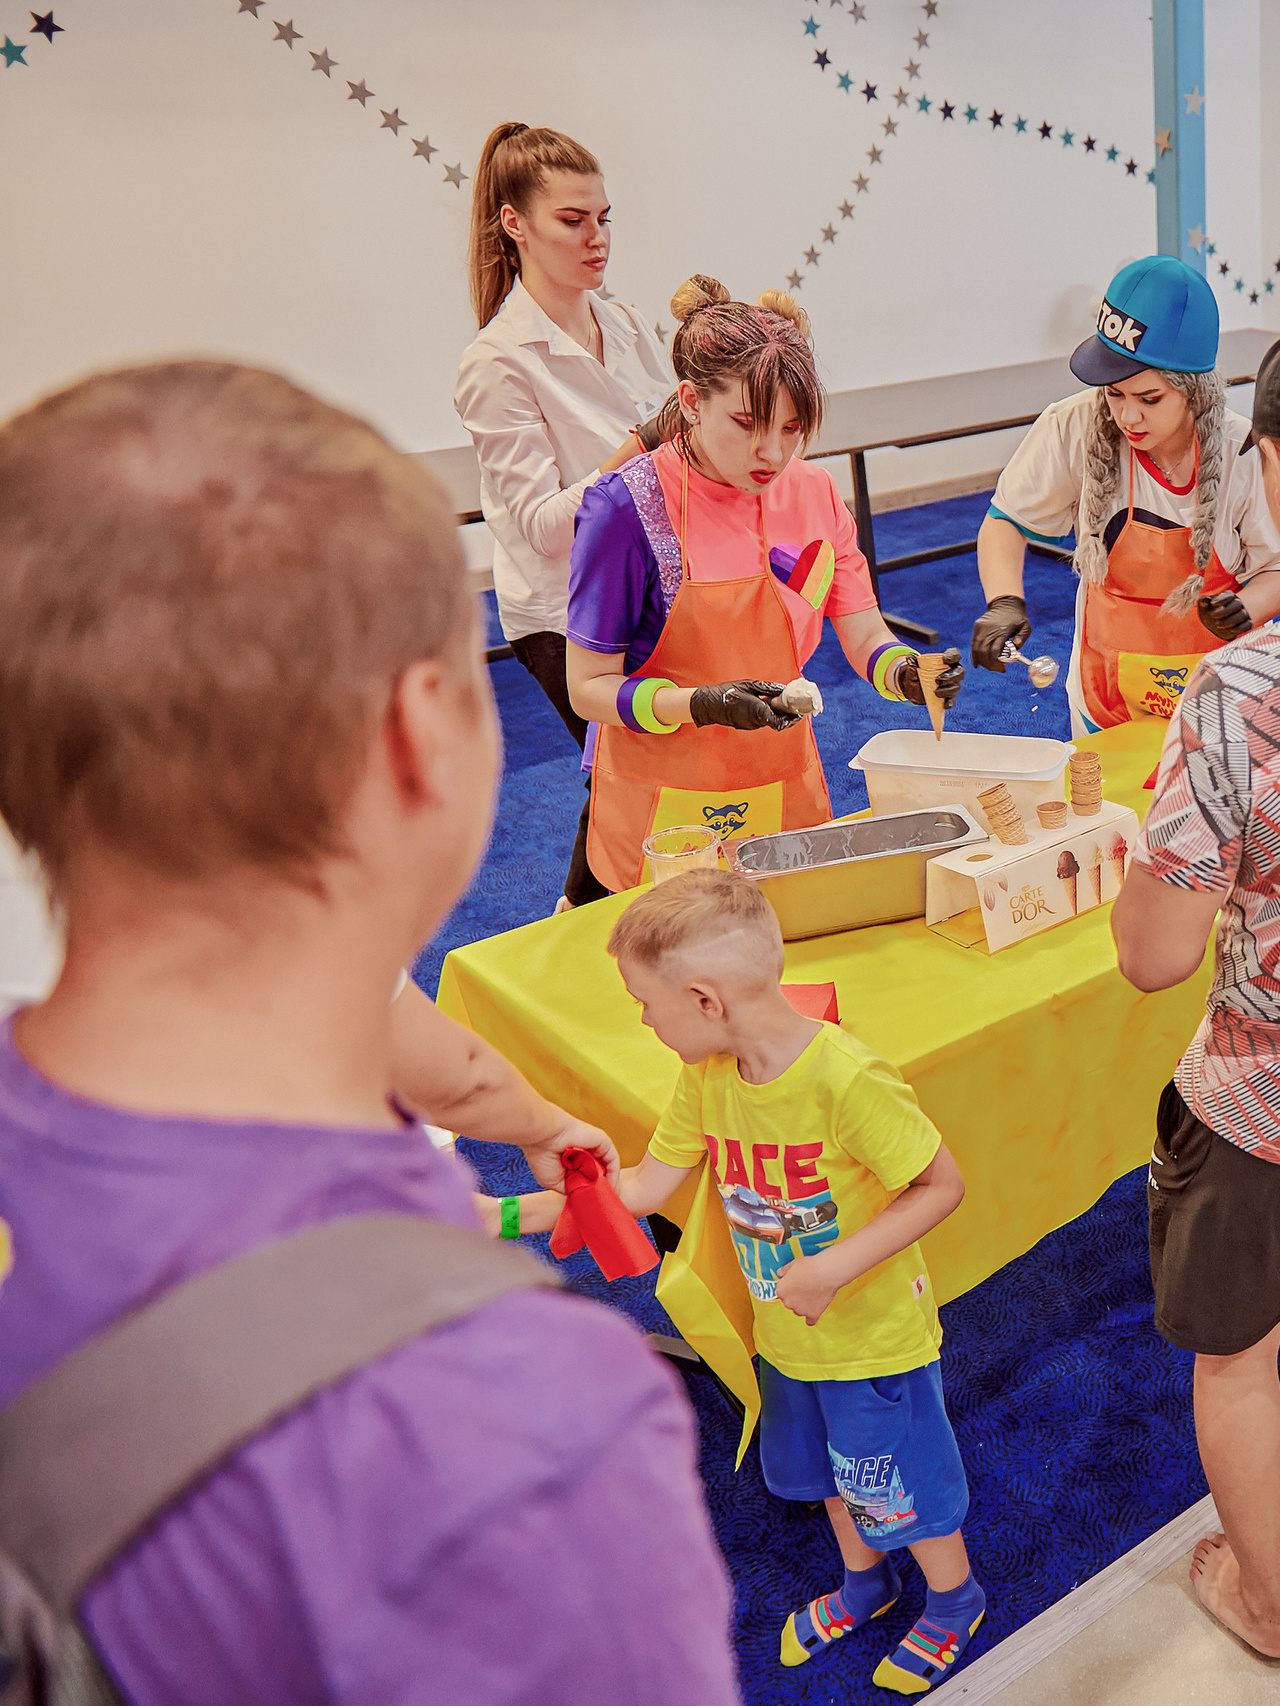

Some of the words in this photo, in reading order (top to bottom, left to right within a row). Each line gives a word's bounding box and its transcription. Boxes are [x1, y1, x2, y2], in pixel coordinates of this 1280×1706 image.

[1097, 301, 1142, 352] Tok
[1009, 885, 1045, 909] CARTE
[1011, 899, 1058, 924] D'OR
[838, 1454, 893, 1489] ACE
